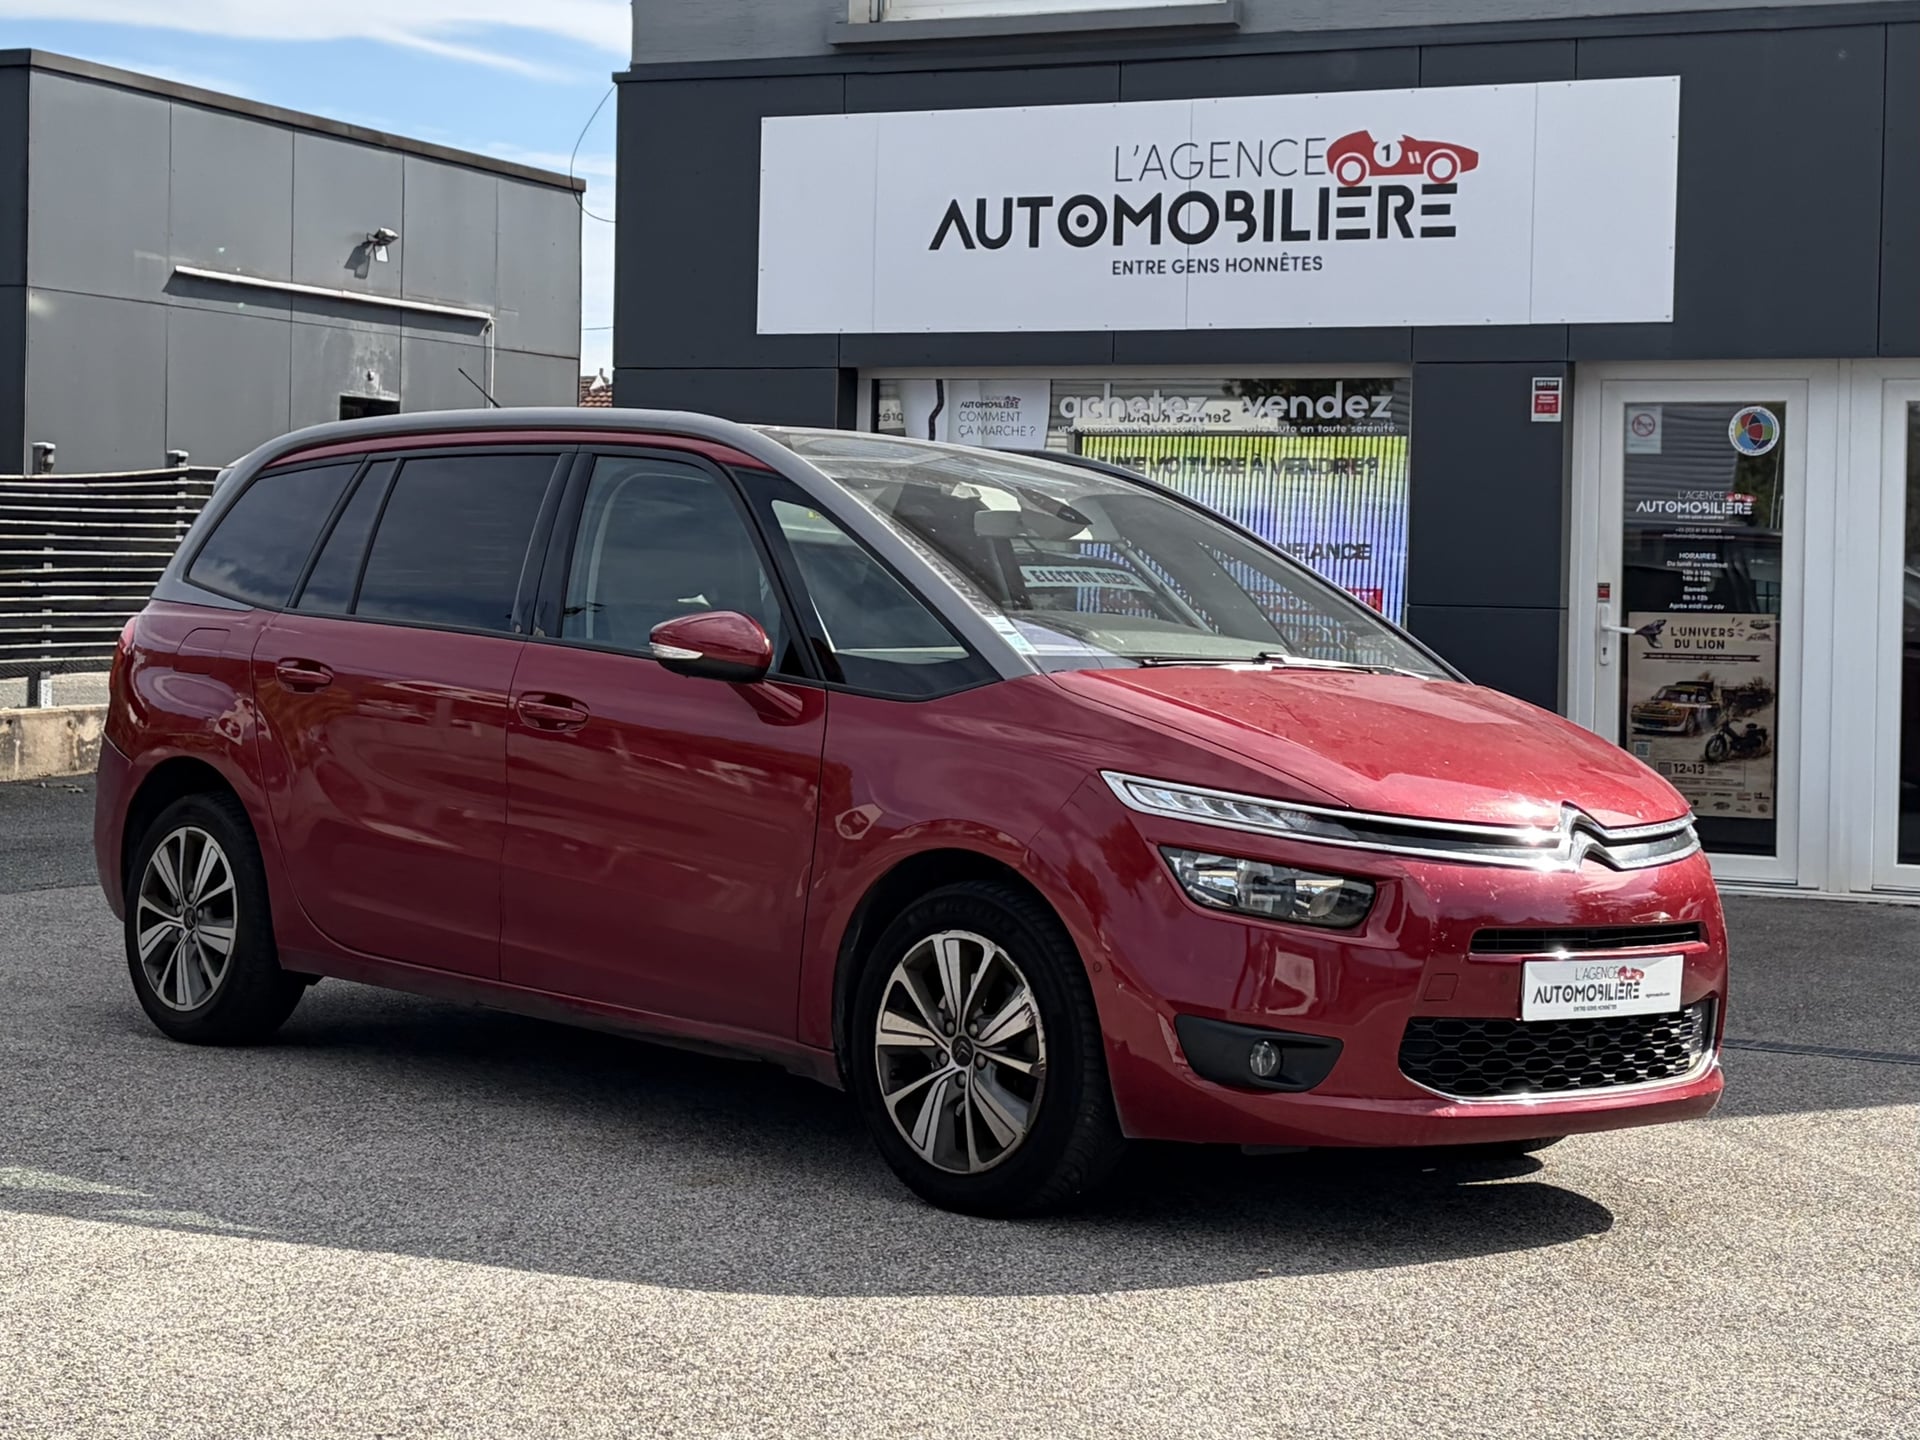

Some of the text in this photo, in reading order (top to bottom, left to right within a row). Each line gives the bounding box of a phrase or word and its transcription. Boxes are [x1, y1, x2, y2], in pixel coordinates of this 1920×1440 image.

[1115, 137, 1327, 182] L'AGENCE
[1381, 143, 1391, 162] 1
[1112, 252, 1323, 275] ENTRE GENS HONNÊTES
[1059, 382, 1209, 419] achetez
[1242, 380, 1393, 419] vendez
[958, 410, 1022, 423] COMMENT
[958, 425, 1036, 438] ÇA MARCHE ?
[1300, 425, 1314, 433] en
[1317, 423, 1347, 433] toute
[1677, 490, 1725, 501] L'AGENCE
[1679, 552, 1716, 560] HORAIRES
[1674, 638, 1725, 650] DU LION
[1575, 966, 1619, 981] L'AGENCE
